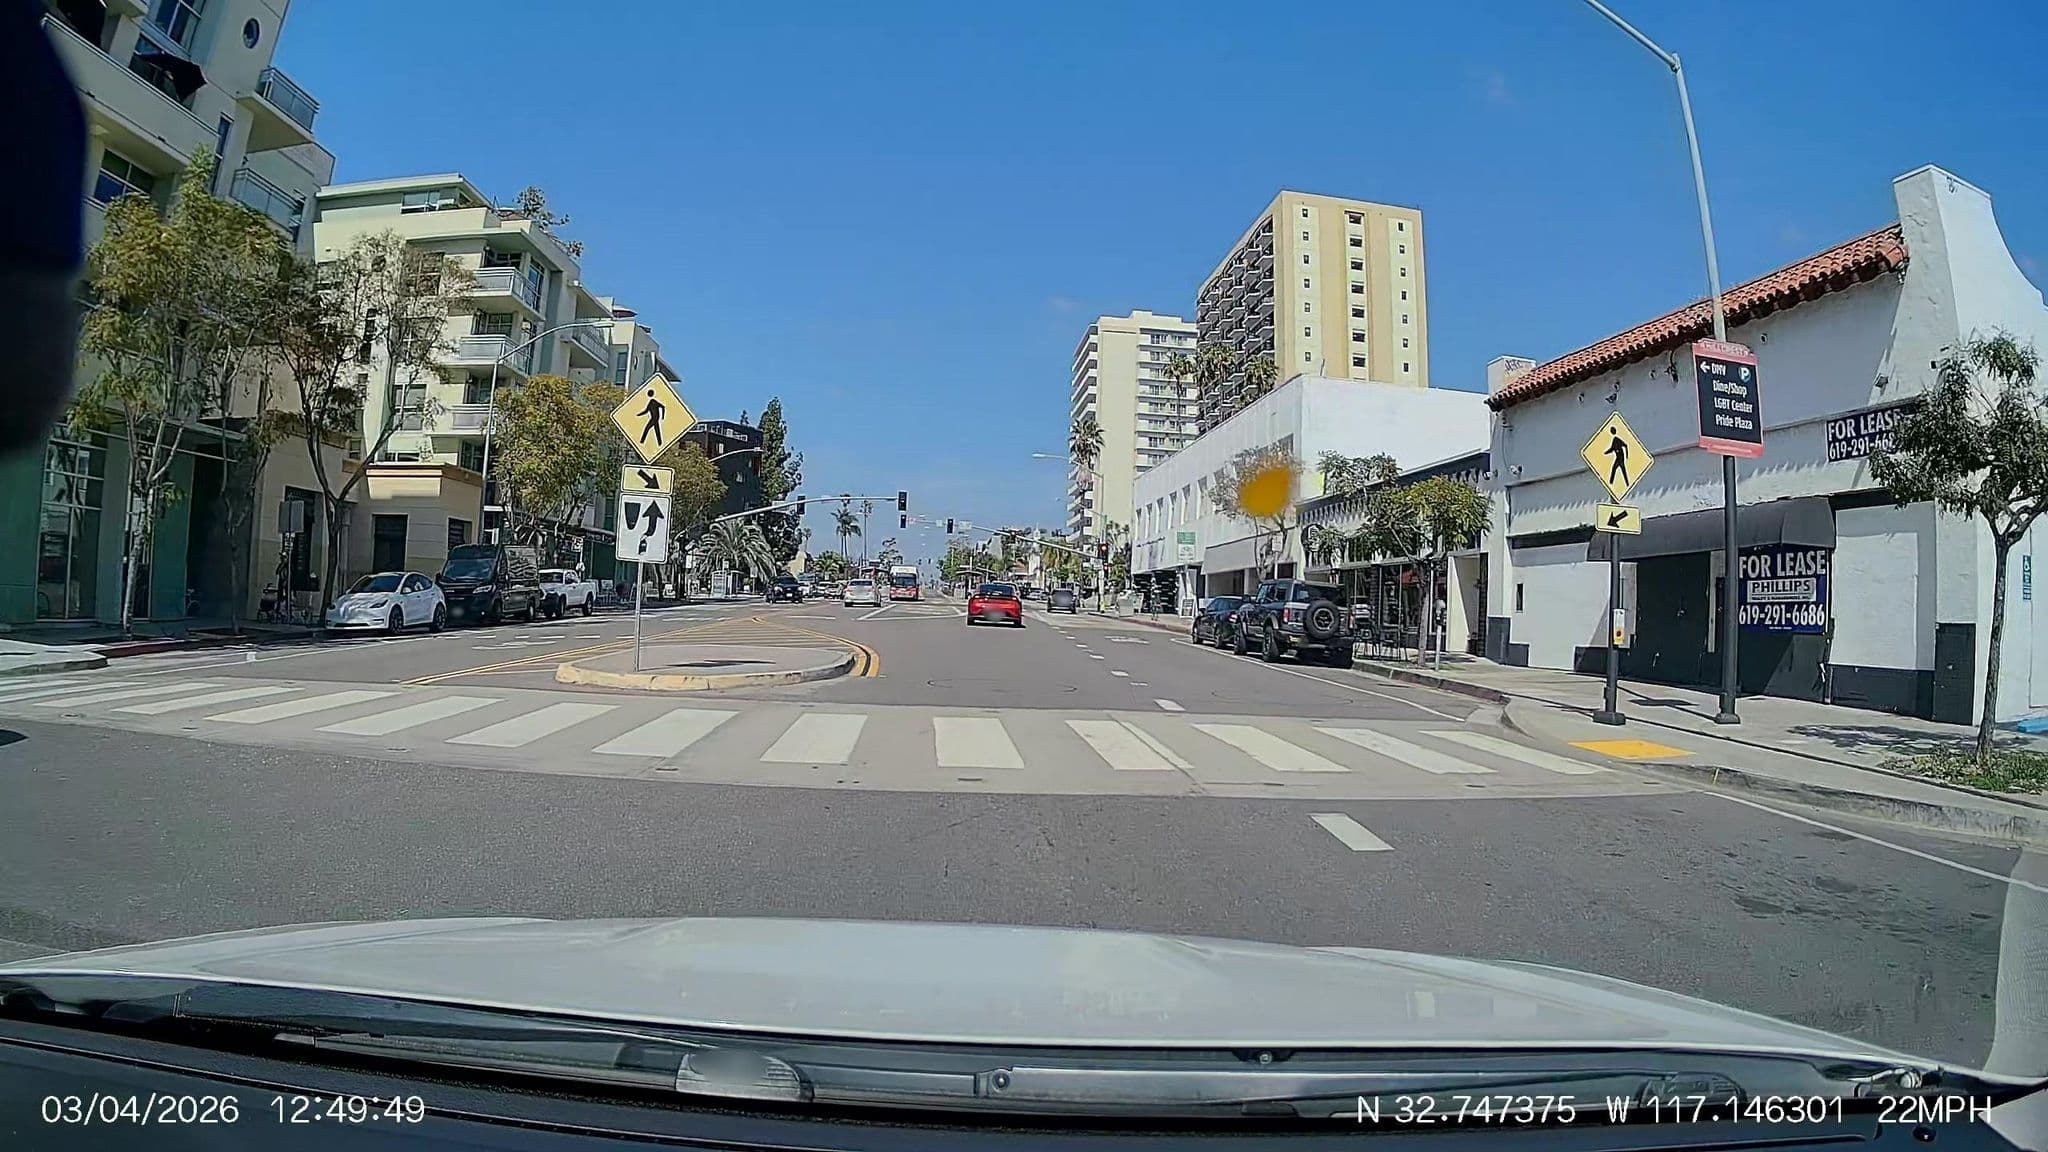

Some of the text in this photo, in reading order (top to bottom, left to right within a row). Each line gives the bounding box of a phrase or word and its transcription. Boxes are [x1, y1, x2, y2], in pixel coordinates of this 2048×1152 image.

[1712, 380, 1747, 398] Dine/Shop
[1714, 397, 1753, 413] LGBT Center
[1715, 414, 1753, 430] Pride Plaza
[1828, 418, 1856, 441] FOR
[1739, 550, 1826, 578] FOR LEASE
[1752, 580, 1810, 593] PHILLIPS
[1739, 603, 1825, 626] 619-291-6686
